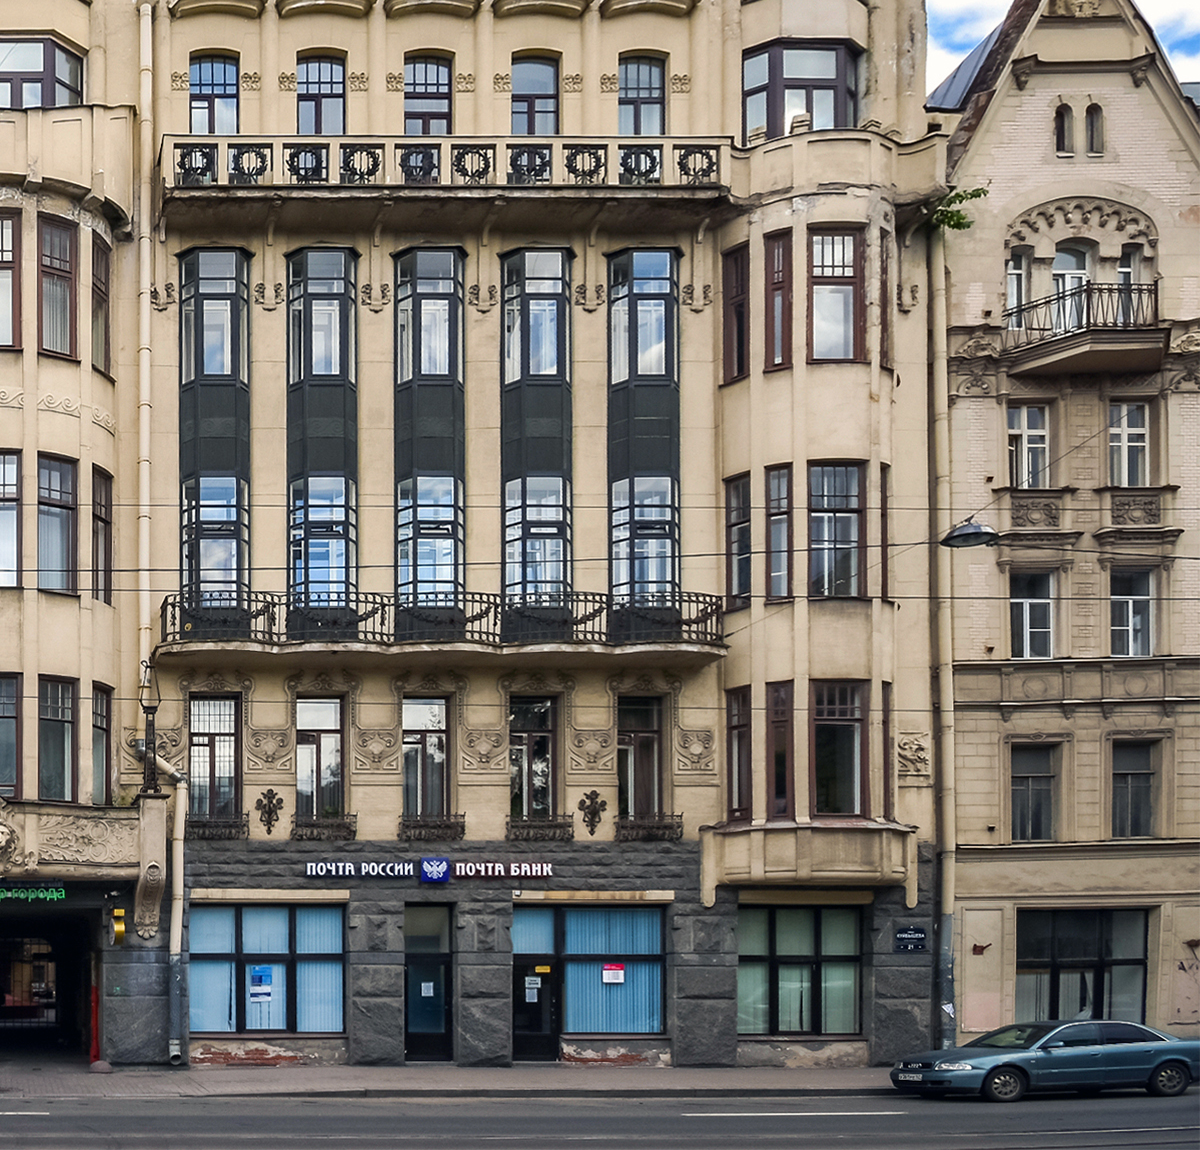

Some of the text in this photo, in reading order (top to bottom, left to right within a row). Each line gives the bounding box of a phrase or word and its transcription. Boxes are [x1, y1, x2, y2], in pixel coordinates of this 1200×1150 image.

[306, 862, 553, 876] ПОЧТА РОССИИ ПОЧТА БАНК
[12, 887, 66, 902] города
